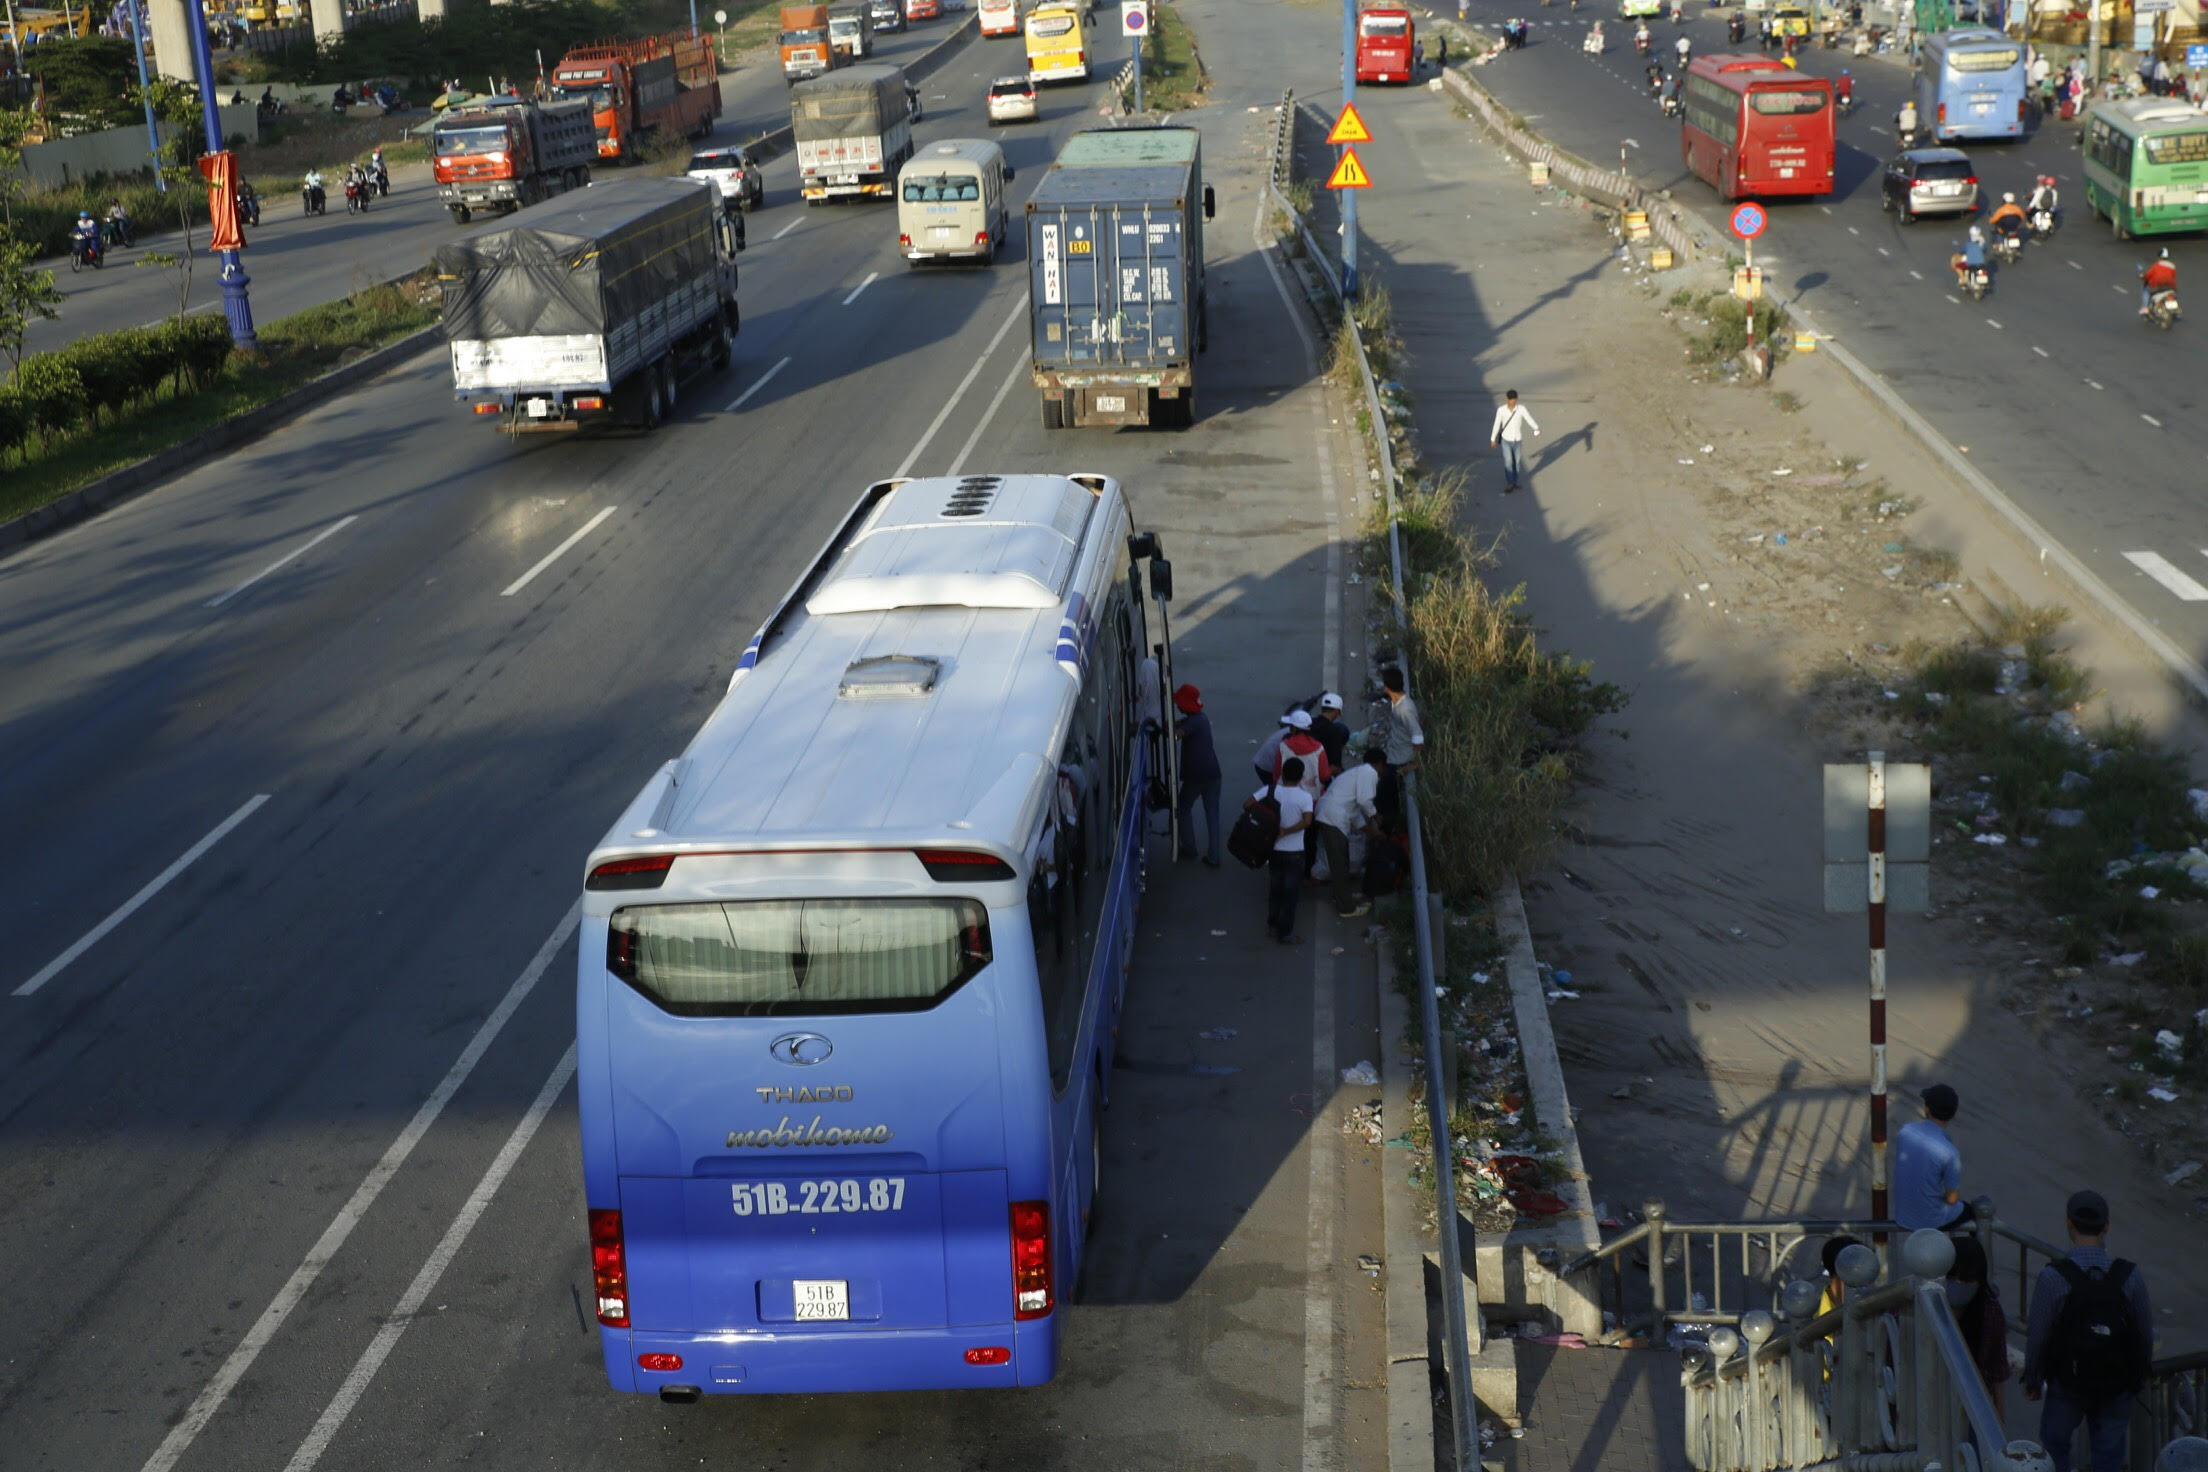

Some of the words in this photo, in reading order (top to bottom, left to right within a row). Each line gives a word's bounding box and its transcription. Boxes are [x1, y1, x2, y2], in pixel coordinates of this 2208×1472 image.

[1121, 224, 1140, 235] WHLU
[1044, 230, 1055, 260] WAN
[1047, 269, 1057, 298] HAI
[756, 1085, 853, 1103] THACO
[726, 1115, 894, 1148] mobihome
[731, 1178, 905, 1216] 51B-229.87
[806, 1285, 835, 1301] 51B
[797, 1302, 845, 1318] 229.87
